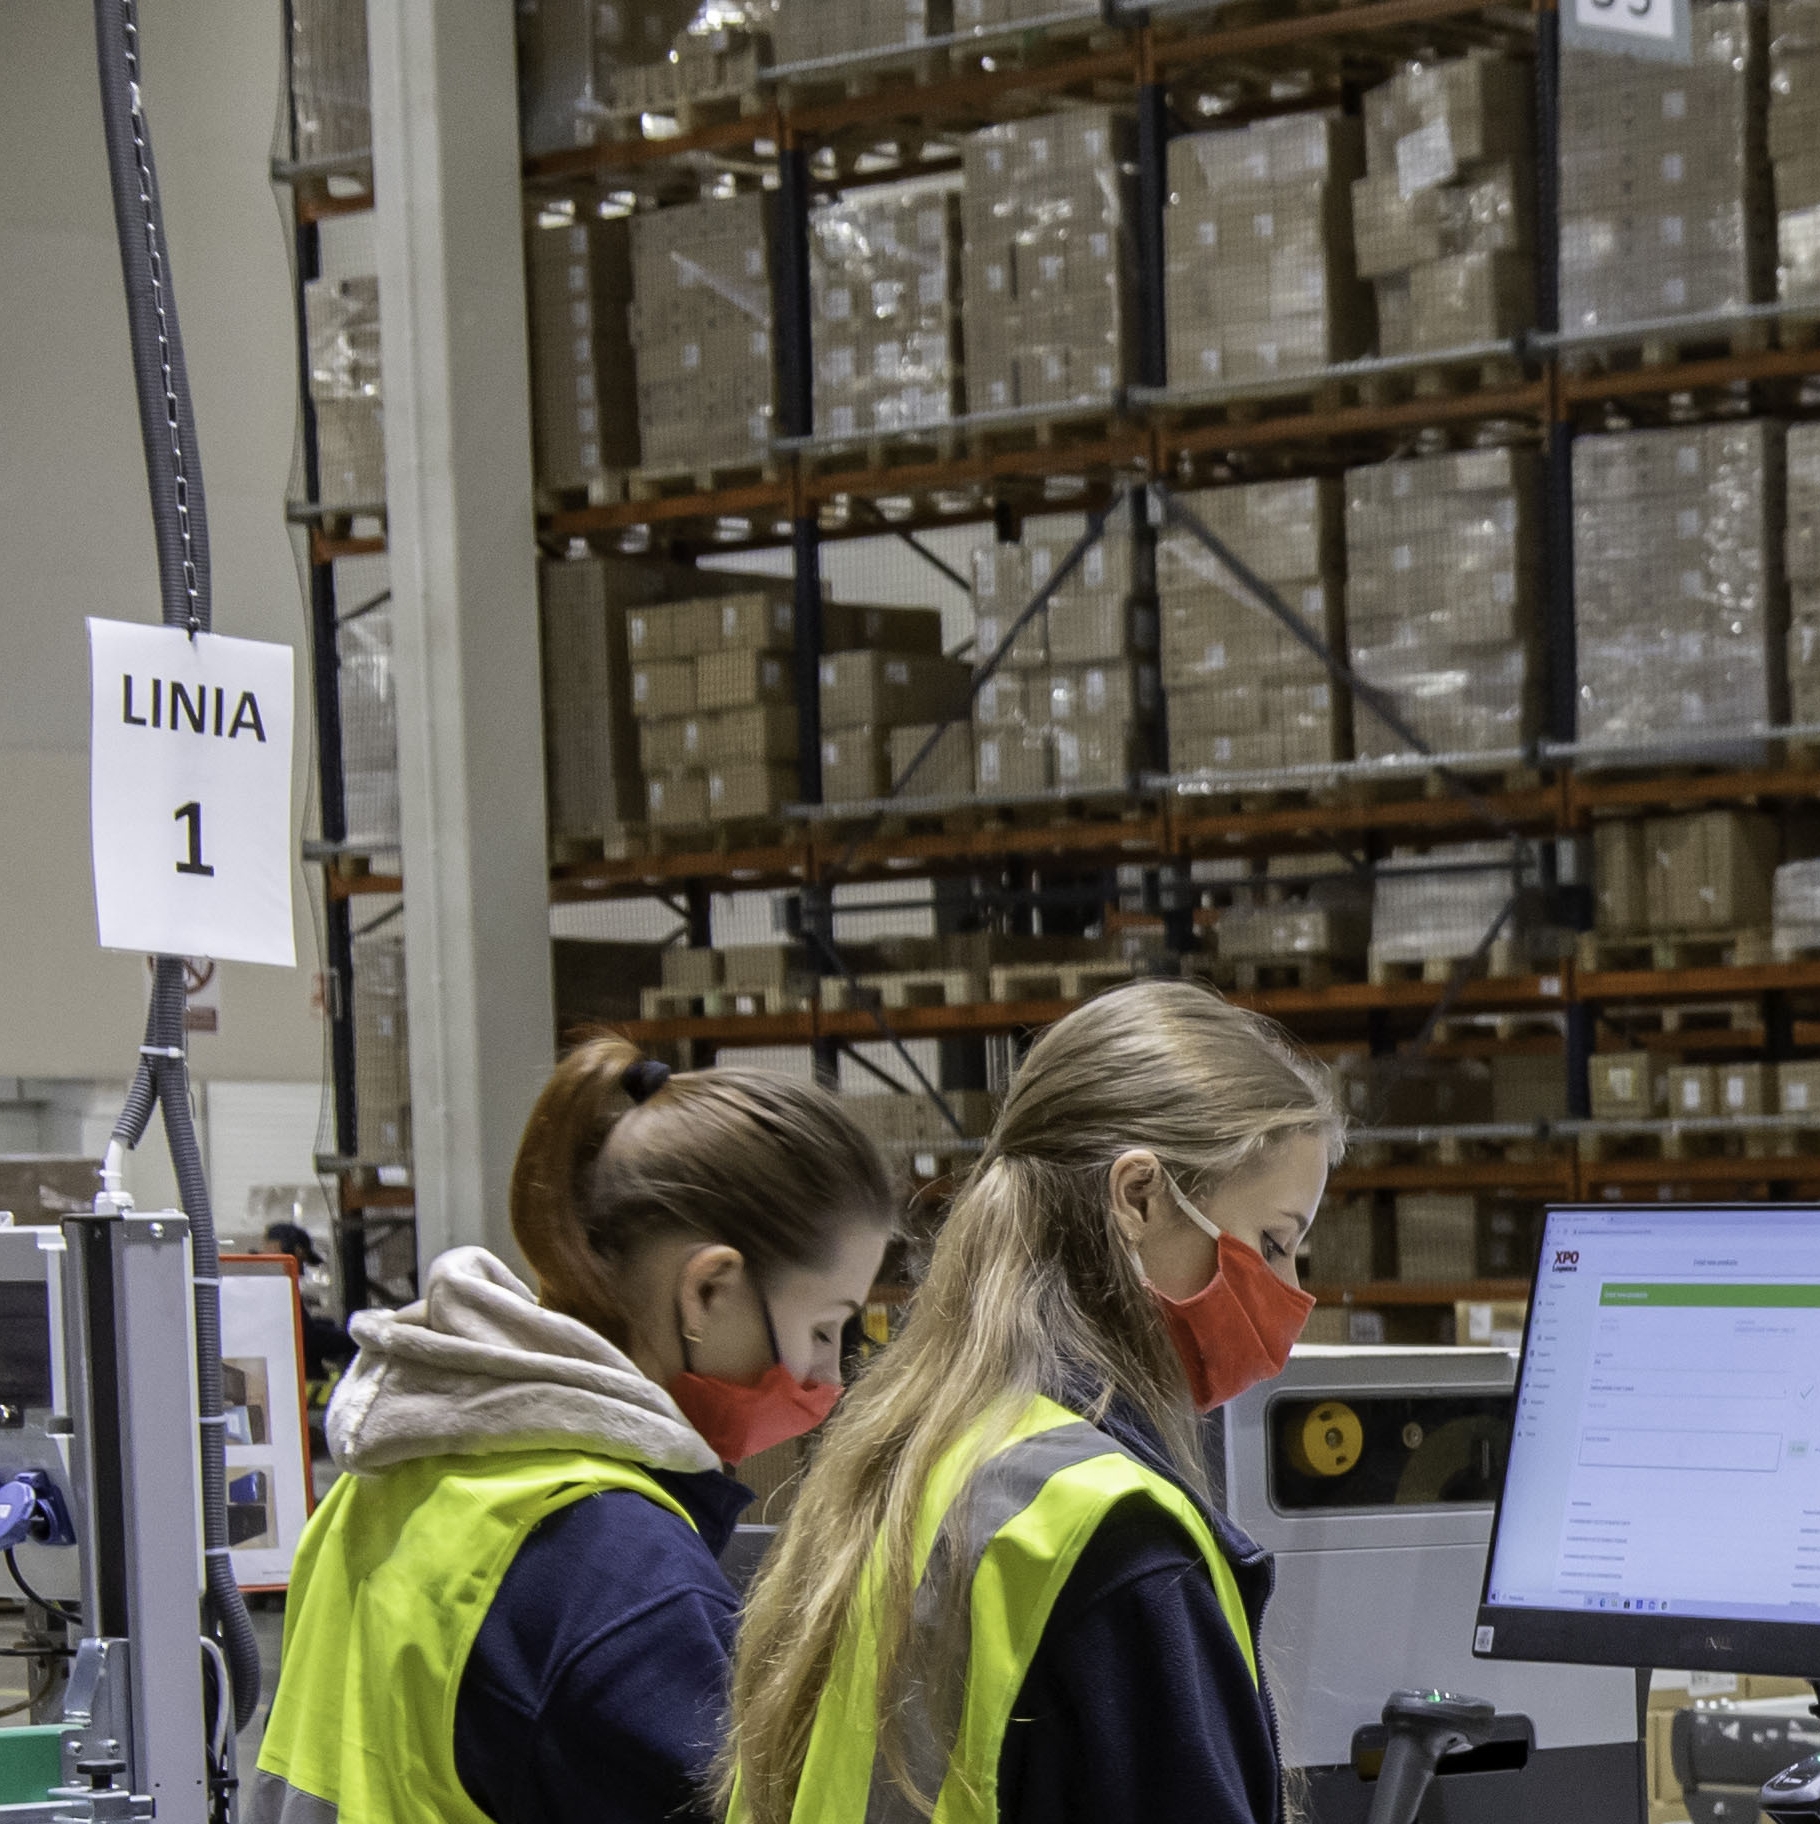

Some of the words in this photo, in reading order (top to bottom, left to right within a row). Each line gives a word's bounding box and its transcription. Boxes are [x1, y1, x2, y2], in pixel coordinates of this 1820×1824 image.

[122, 674, 267, 743] LINIA
[173, 801, 214, 877] 1
[1554, 1250, 1580, 1264] XPO
